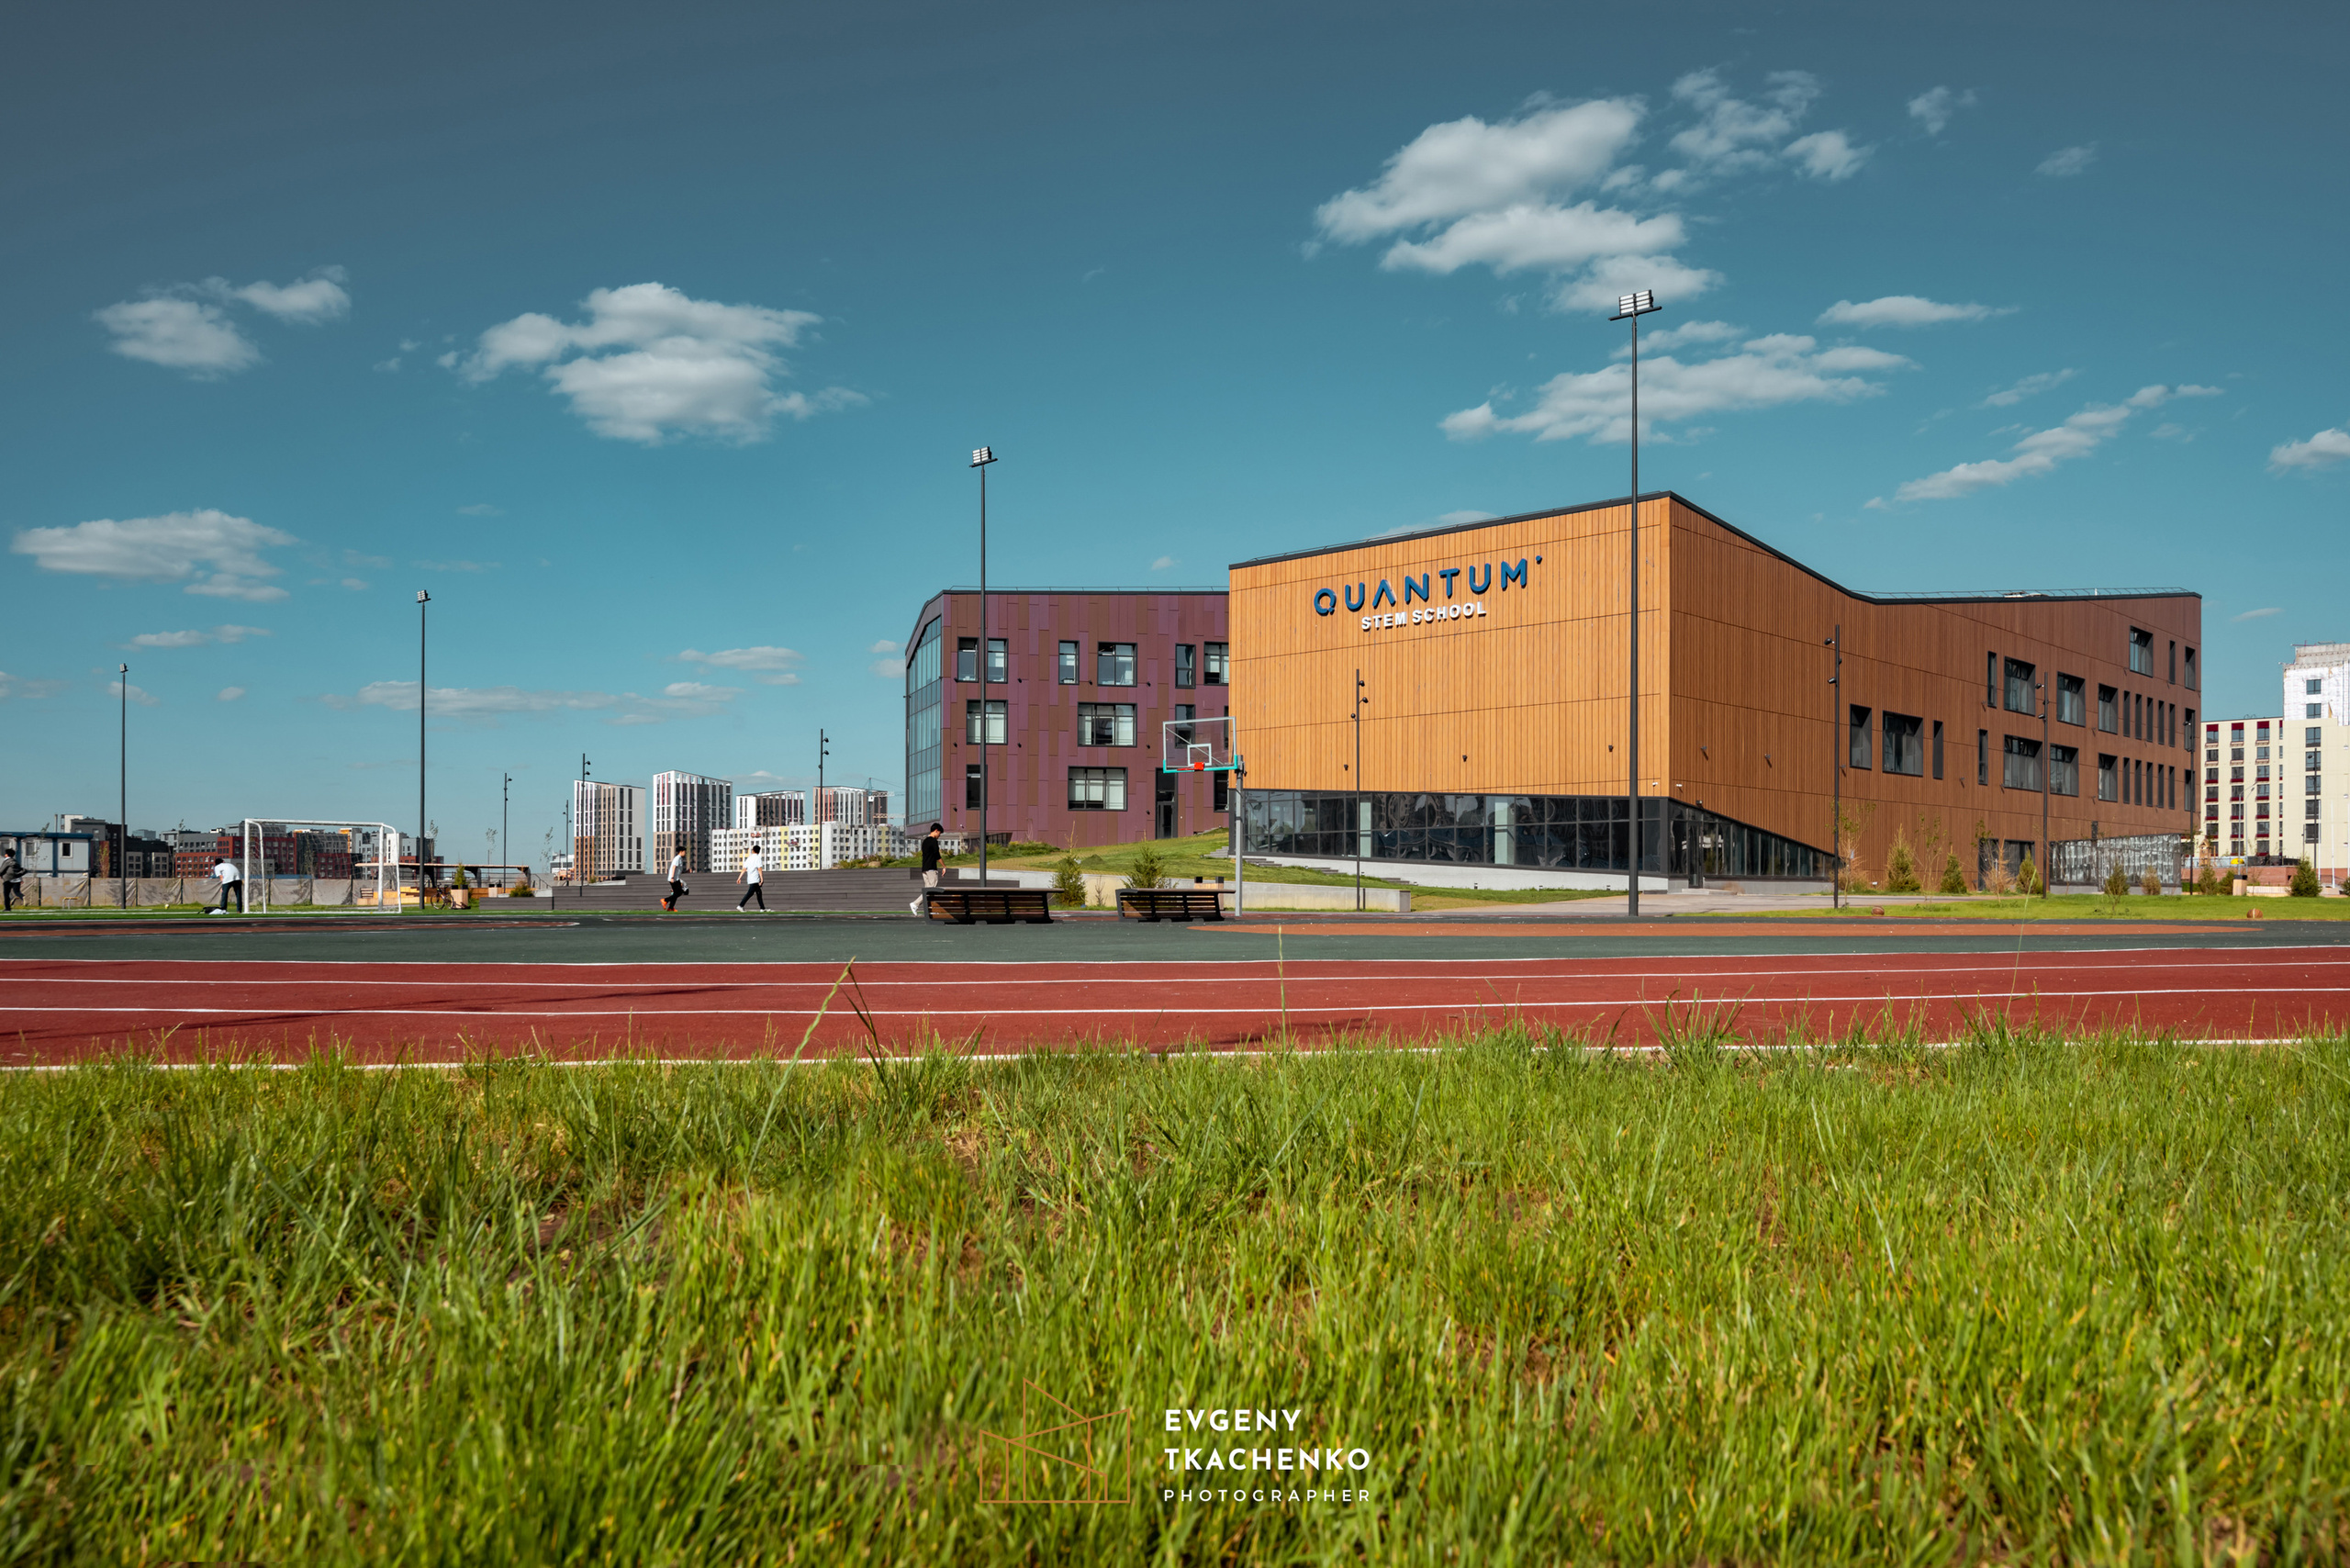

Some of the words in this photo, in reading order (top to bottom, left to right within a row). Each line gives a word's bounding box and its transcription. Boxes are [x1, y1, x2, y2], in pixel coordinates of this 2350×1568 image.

[1314, 557, 1528, 615] QUANTUM
[1361, 611, 1407, 630] STEM
[1412, 601, 1487, 623] SCHOOL
